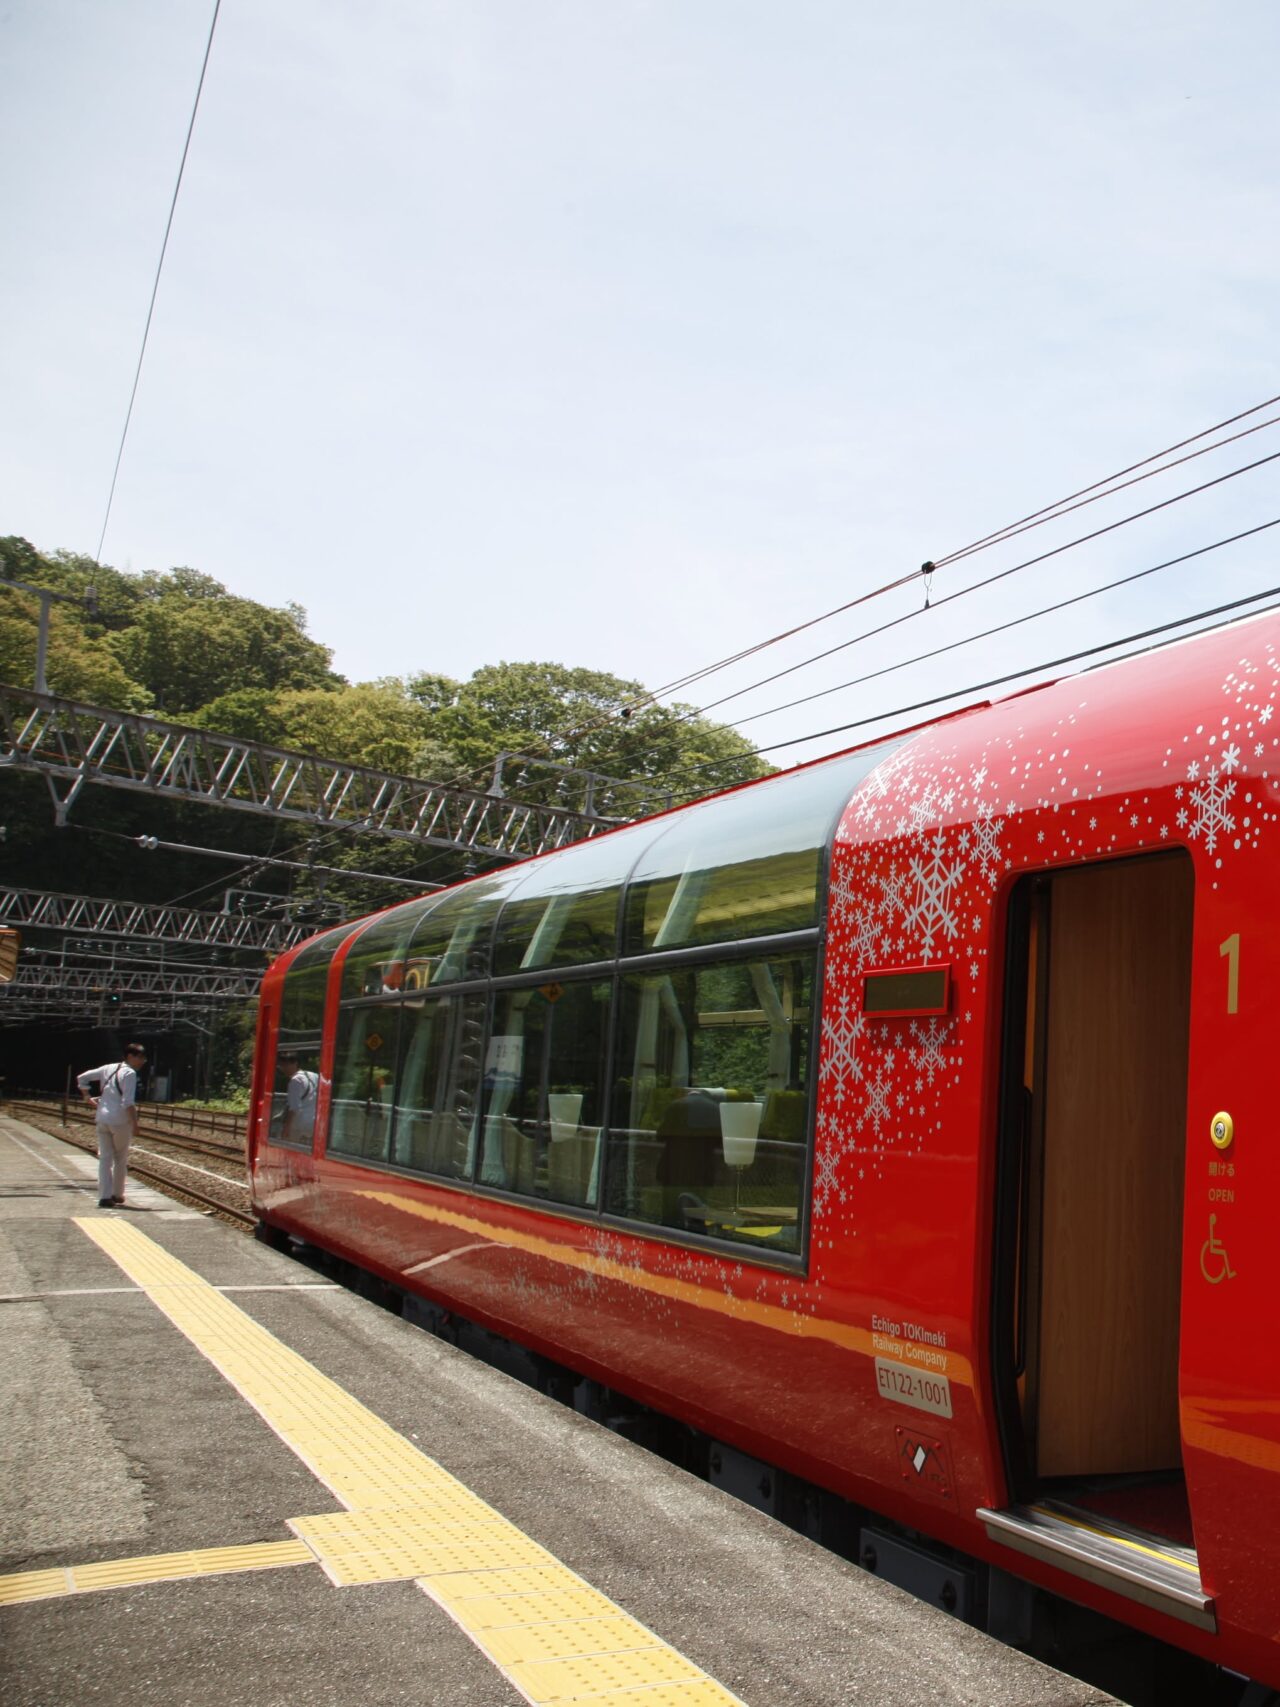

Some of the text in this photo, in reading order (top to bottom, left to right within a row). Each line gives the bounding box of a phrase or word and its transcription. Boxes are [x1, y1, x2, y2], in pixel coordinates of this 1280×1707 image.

[1220, 933, 1241, 1014] 1
[1208, 1161, 1235, 1177] 開ける
[1208, 1188, 1235, 1203] OPEN
[872, 1314, 946, 1347] Echigo TOKImeki
[873, 1333, 947, 1371] Railway Company
[878, 1366, 949, 1407] ET122-1001
